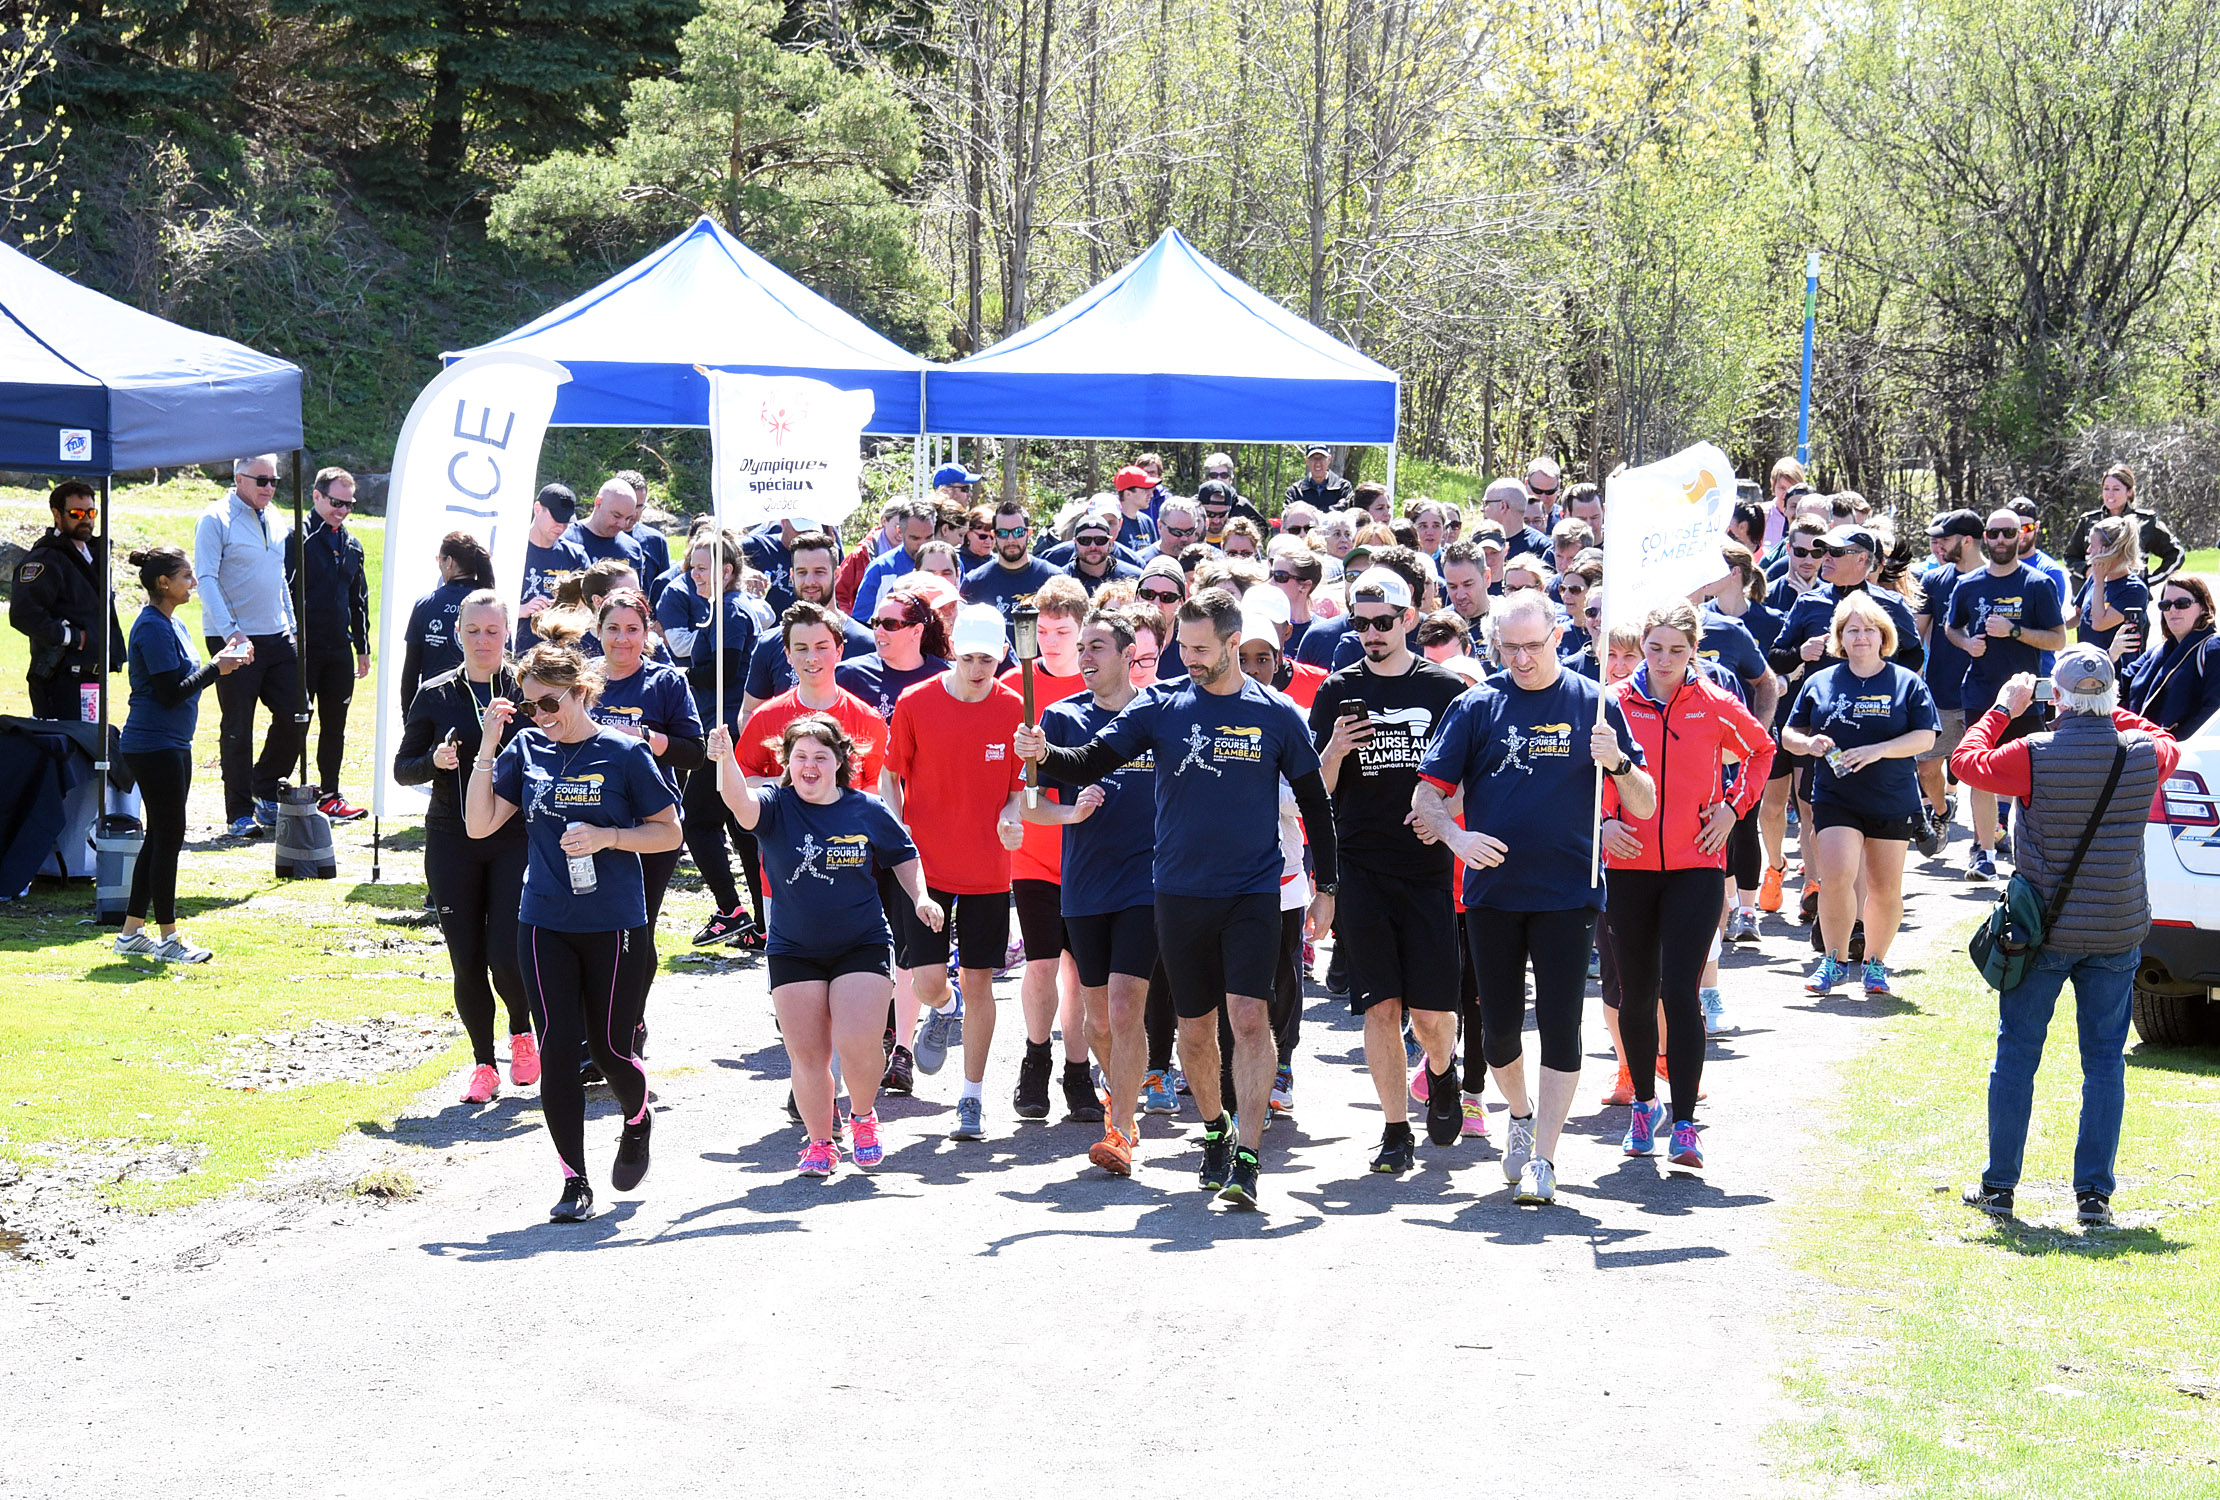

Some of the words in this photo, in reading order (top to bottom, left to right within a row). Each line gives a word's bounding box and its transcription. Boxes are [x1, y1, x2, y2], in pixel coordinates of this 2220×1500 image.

[740, 457, 828, 475] Olympiques
[749, 477, 814, 494] spéciaux
[1642, 522, 1702, 553] COSE
[1642, 538, 1711, 567] FMBE
[443, 604, 460, 613] 201
[1214, 740, 1249, 750] COURSE
[1411, 738, 1430, 750] AU
[1213, 747, 1261, 759] FLAMBEAU
[1528, 745, 1570, 754] FAMBEAU
[1120, 760, 1155, 768] AMBEAU
[555, 786, 588, 795] COURSE
[554, 793, 601, 802] FLAMBEAU
[826, 849, 859, 857] COURSE
[860, 849, 867, 857] AU
[826, 856, 867, 864] FLAMBEAU
